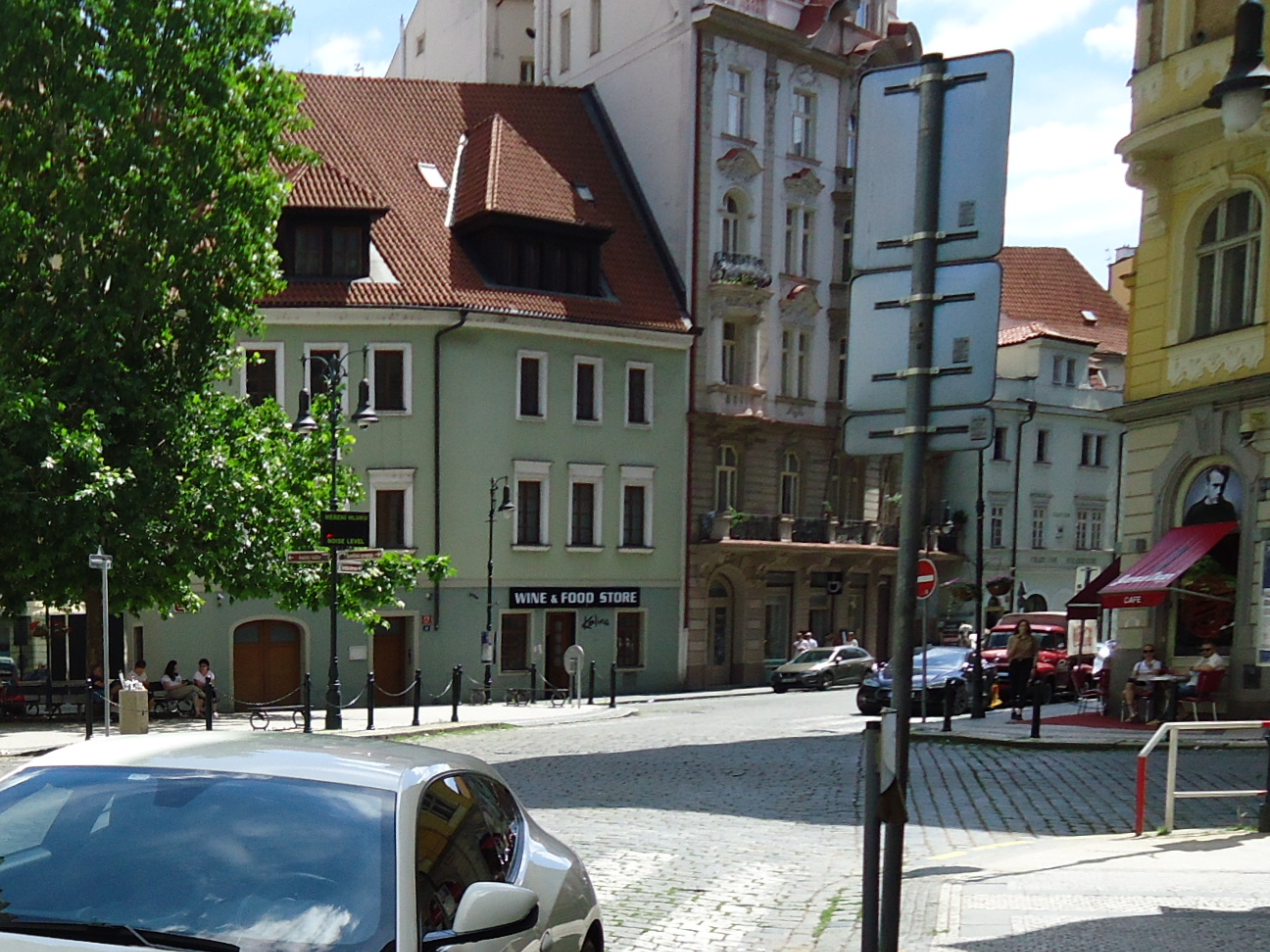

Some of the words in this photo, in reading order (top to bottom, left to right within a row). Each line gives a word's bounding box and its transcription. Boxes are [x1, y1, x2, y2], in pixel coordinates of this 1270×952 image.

[514, 592, 548, 604] WINE
[550, 594, 558, 604] &
[561, 592, 595, 604] FOOD
[599, 591, 638, 603] STORE
